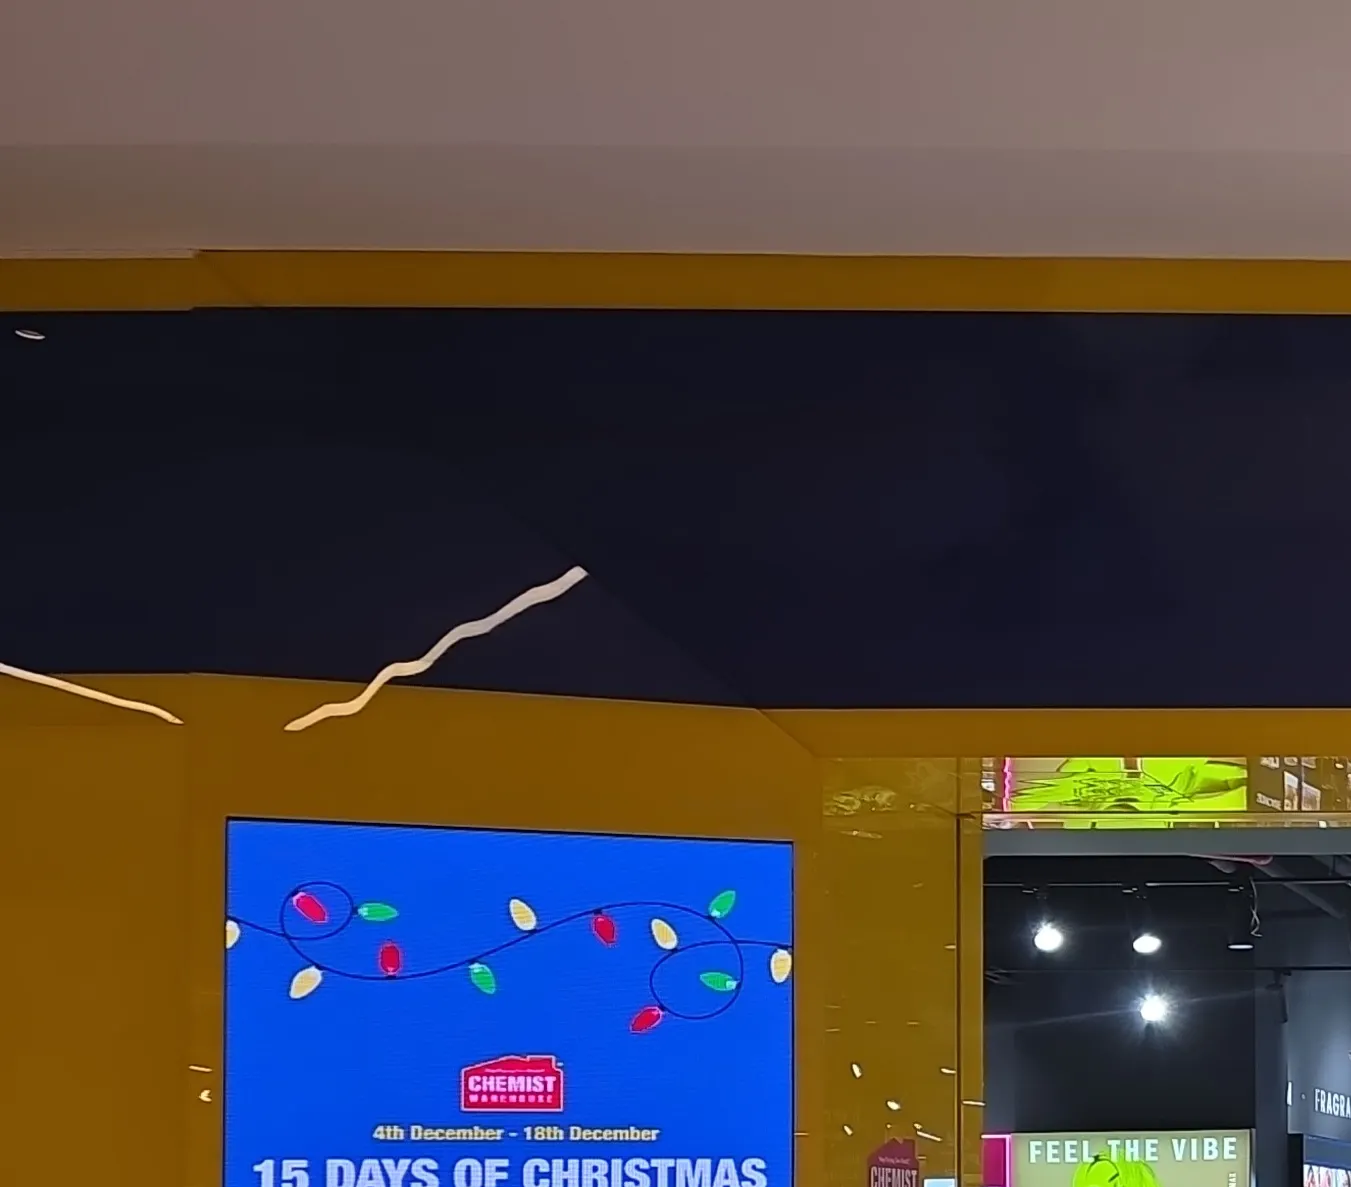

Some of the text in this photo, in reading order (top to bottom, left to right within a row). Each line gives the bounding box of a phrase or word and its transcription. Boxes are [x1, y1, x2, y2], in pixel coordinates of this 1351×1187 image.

[468, 1075, 557, 1092] CHEMIST
[373, 1125, 404, 1141] 4th
[410, 1125, 504, 1142] December
[523, 1125, 565, 1141] 18th
[570, 1125, 660, 1142] December
[1029, 1136, 1237, 1164] FEEL THE VIBE
